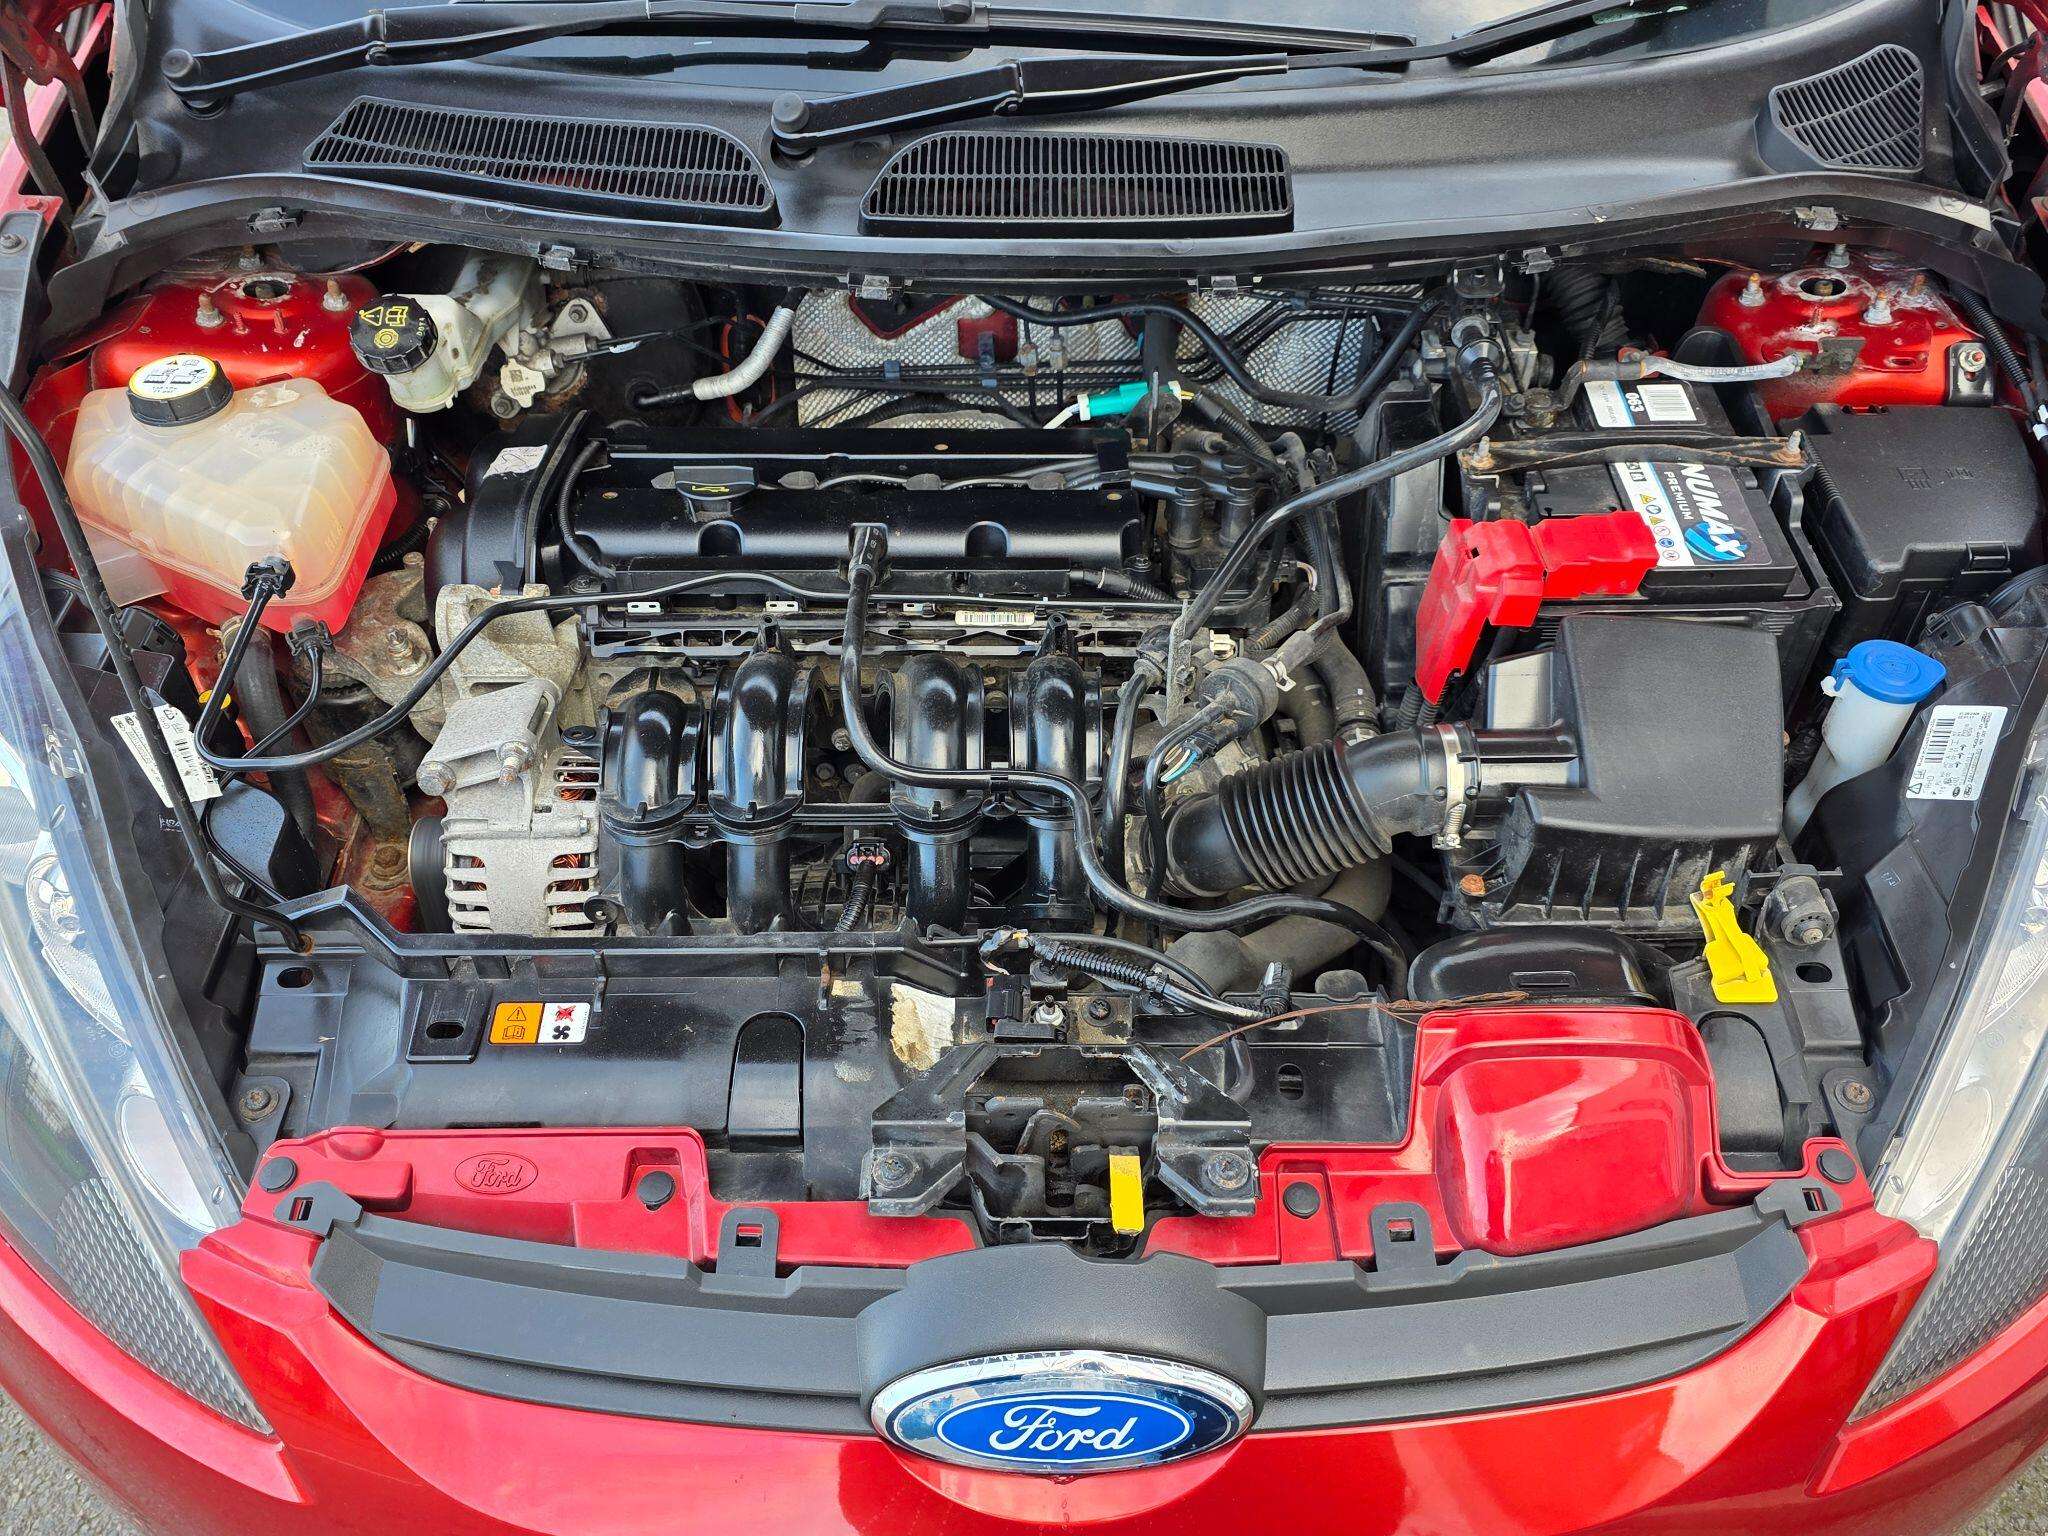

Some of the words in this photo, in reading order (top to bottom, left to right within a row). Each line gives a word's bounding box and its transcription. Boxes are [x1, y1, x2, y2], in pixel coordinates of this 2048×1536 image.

[1663, 471, 1694, 520] PREMIUM
[1679, 462, 1746, 558] NUMAX
[471, 1158, 524, 1188] Ford
[988, 1404, 1139, 1451] Ford
